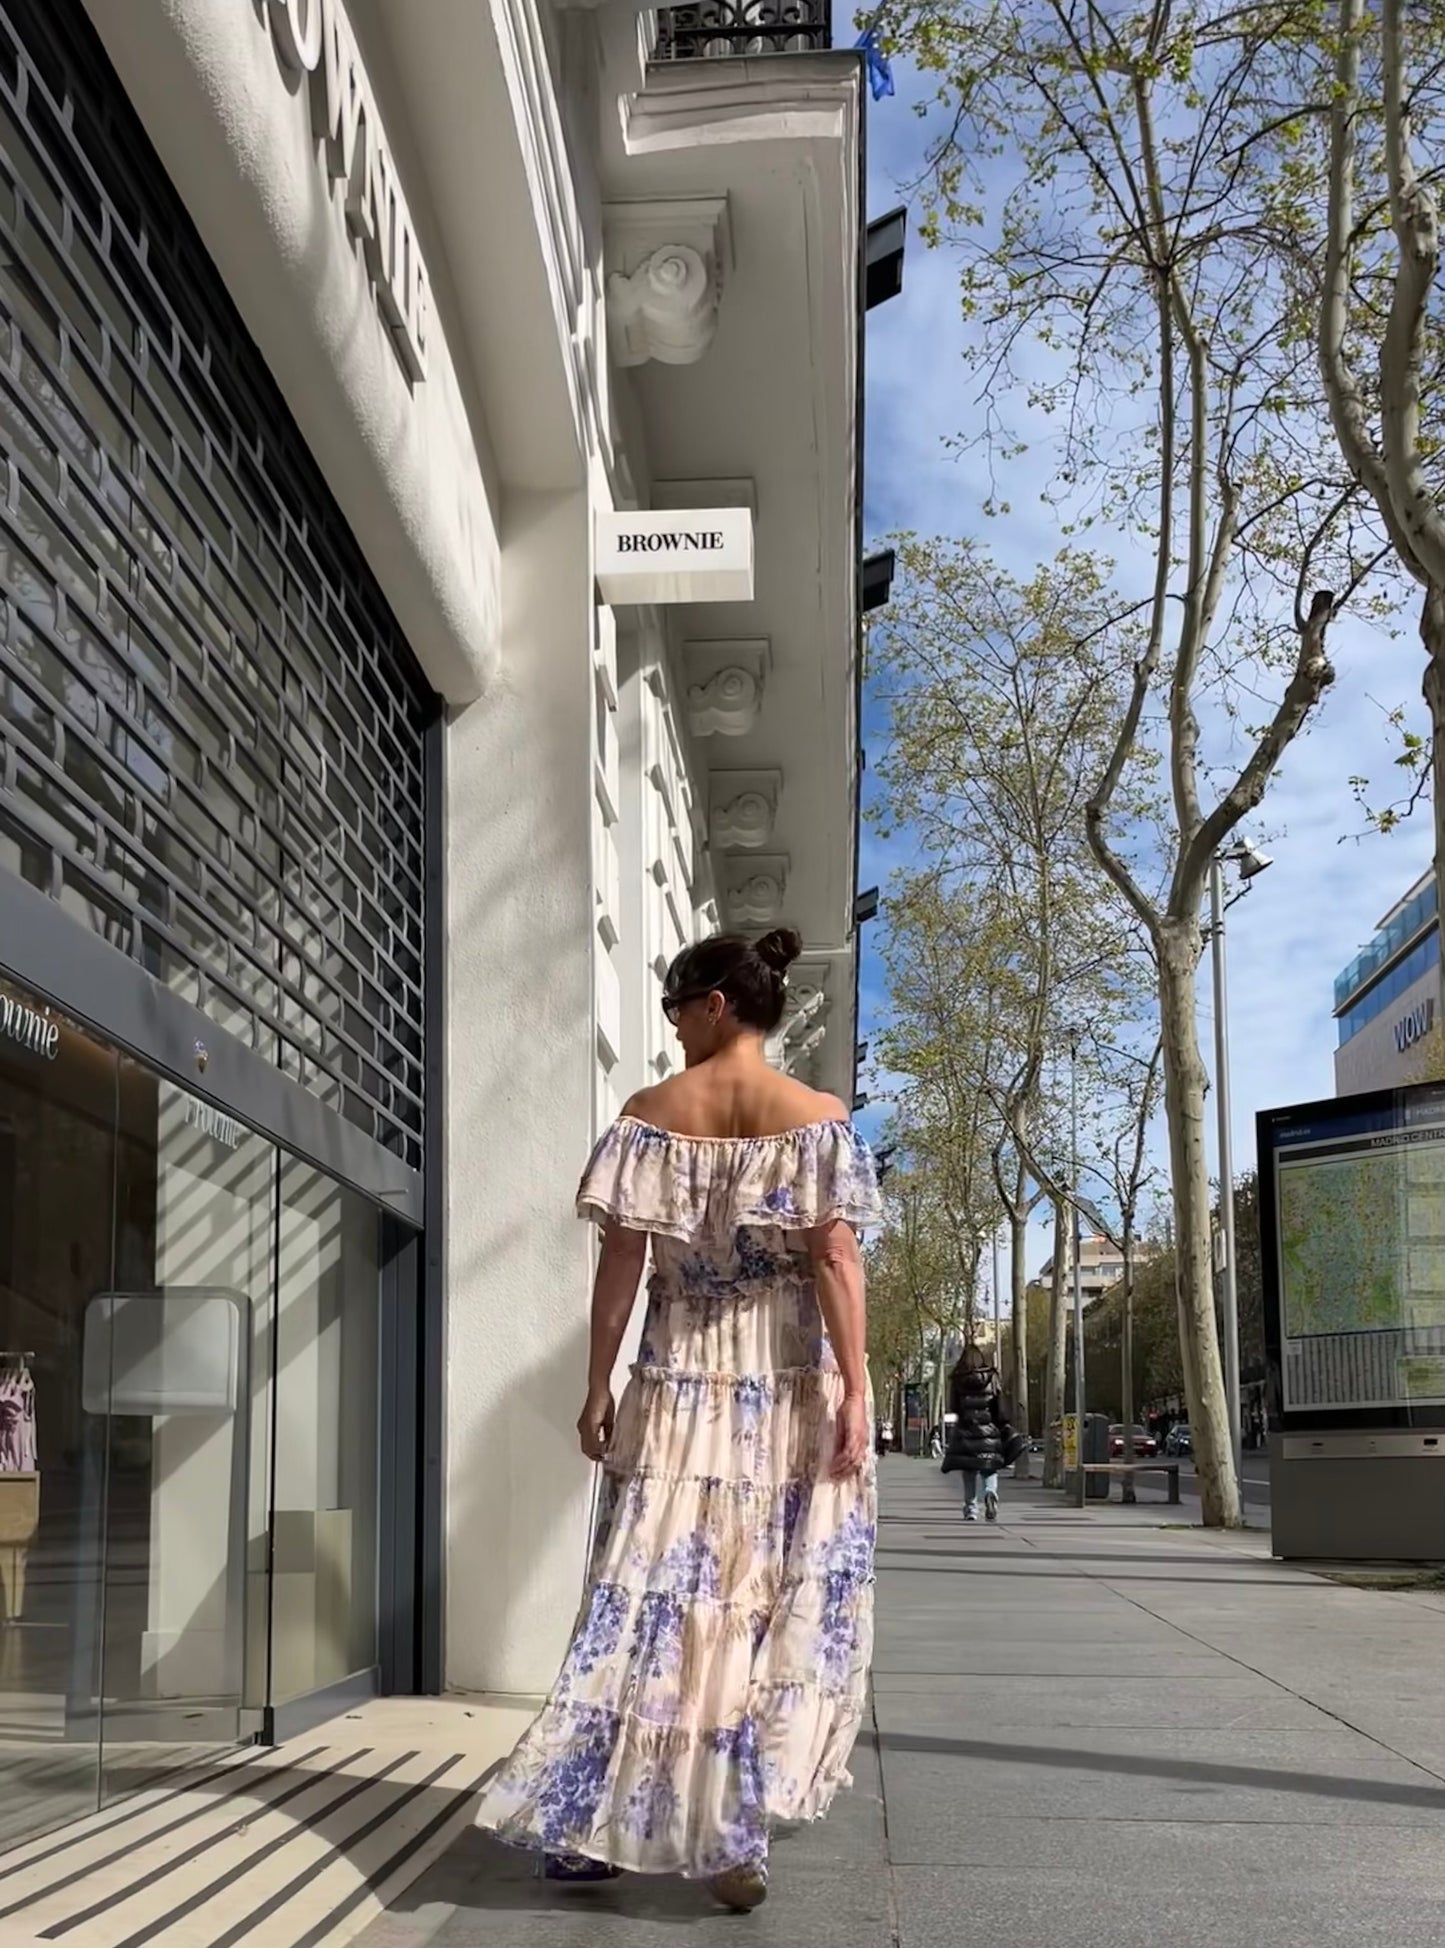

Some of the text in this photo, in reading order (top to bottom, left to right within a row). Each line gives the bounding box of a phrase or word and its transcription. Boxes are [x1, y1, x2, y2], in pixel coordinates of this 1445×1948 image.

[262, 0, 428, 382] OWNIE
[617, 531, 724, 553] BROWNIE
[1370, 1134, 1410, 1147] MADRID
